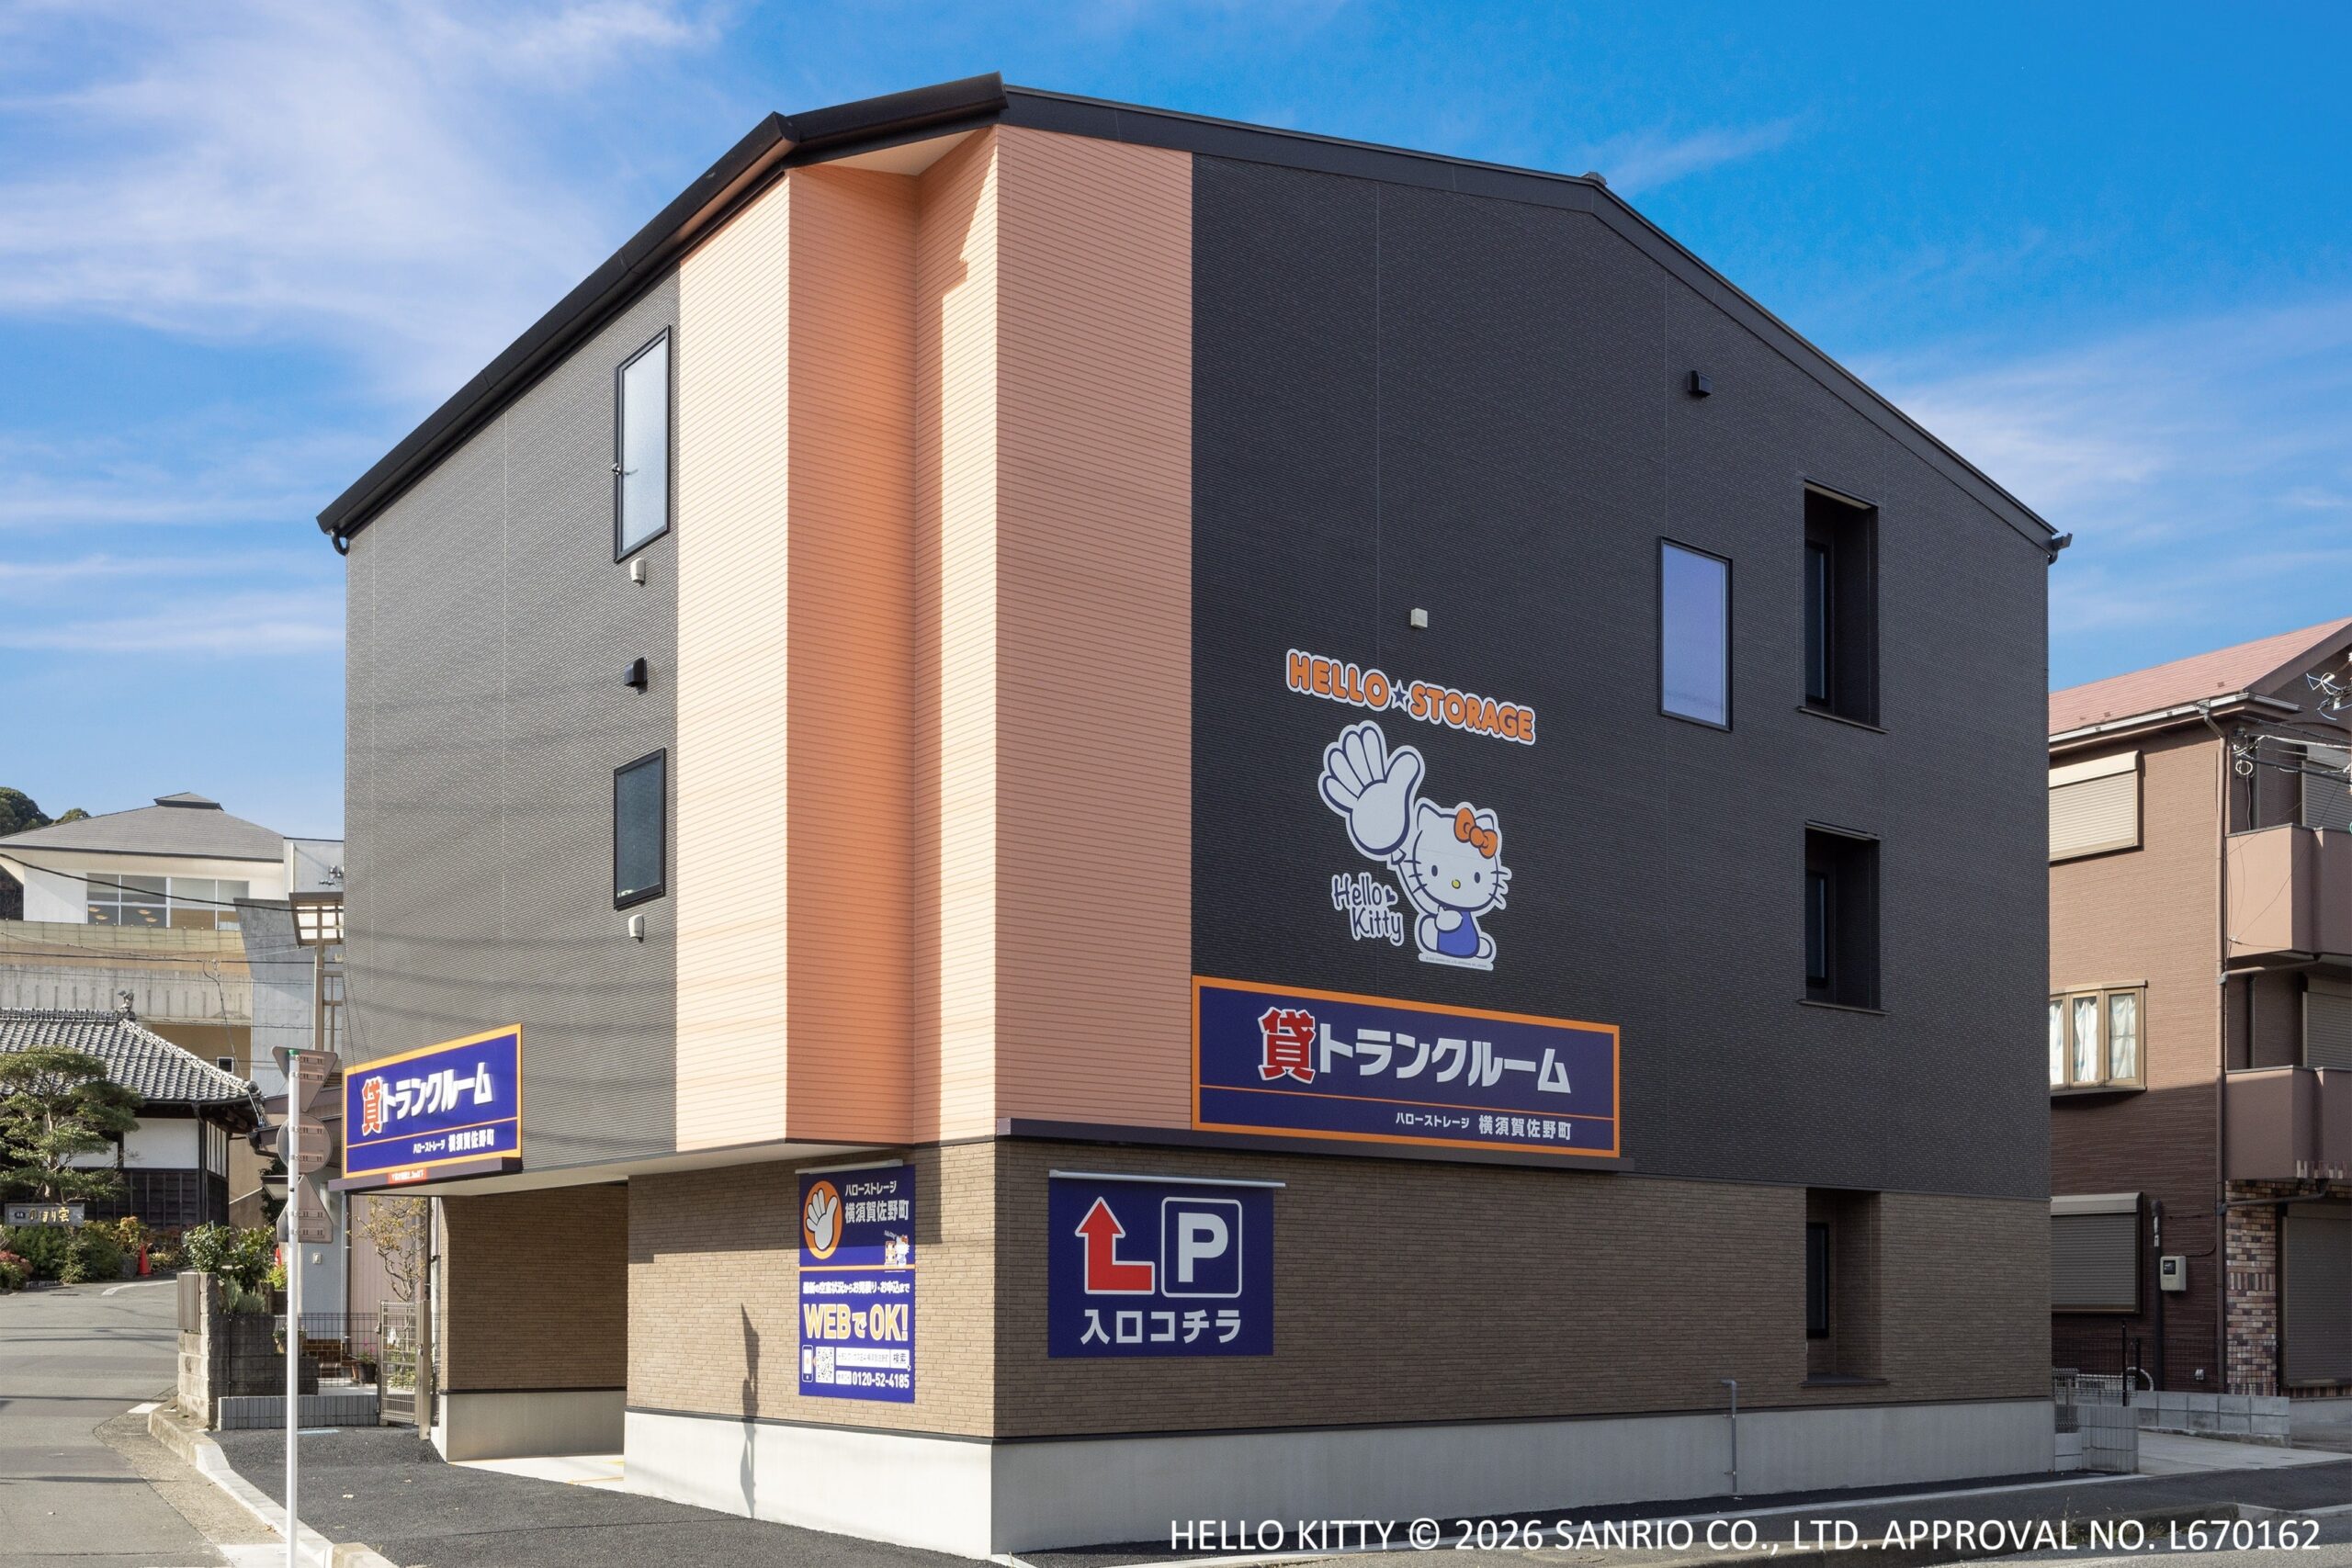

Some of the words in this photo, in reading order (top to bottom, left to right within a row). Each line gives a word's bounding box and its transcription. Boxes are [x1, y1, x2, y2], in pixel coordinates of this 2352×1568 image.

[1287, 649, 1391, 710] HELLO
[1408, 682, 1535, 744] STORAGE
[1334, 874, 1382, 909] Hello
[1352, 906, 1403, 944] Kitty
[1258, 1007, 1571, 1093] 貸トランクルーム
[362, 1062, 493, 1136] 貸トランクルーム
[1396, 1112, 1470, 1129] ハローストレージ
[1478, 1114, 1572, 1141] 横須賀佐野町
[413, 1139, 445, 1154] ハローストレージ
[845, 1180, 897, 1196] ハローストレージ
[845, 1200, 910, 1224] 横須賀佐野町
[1178, 1212, 1229, 1282] P
[803, 1303, 909, 1341] WEBでOK!
[1080, 1309, 1241, 1345] 入口コチラ
[852, 1371, 910, 1389] 0120-52-4185
